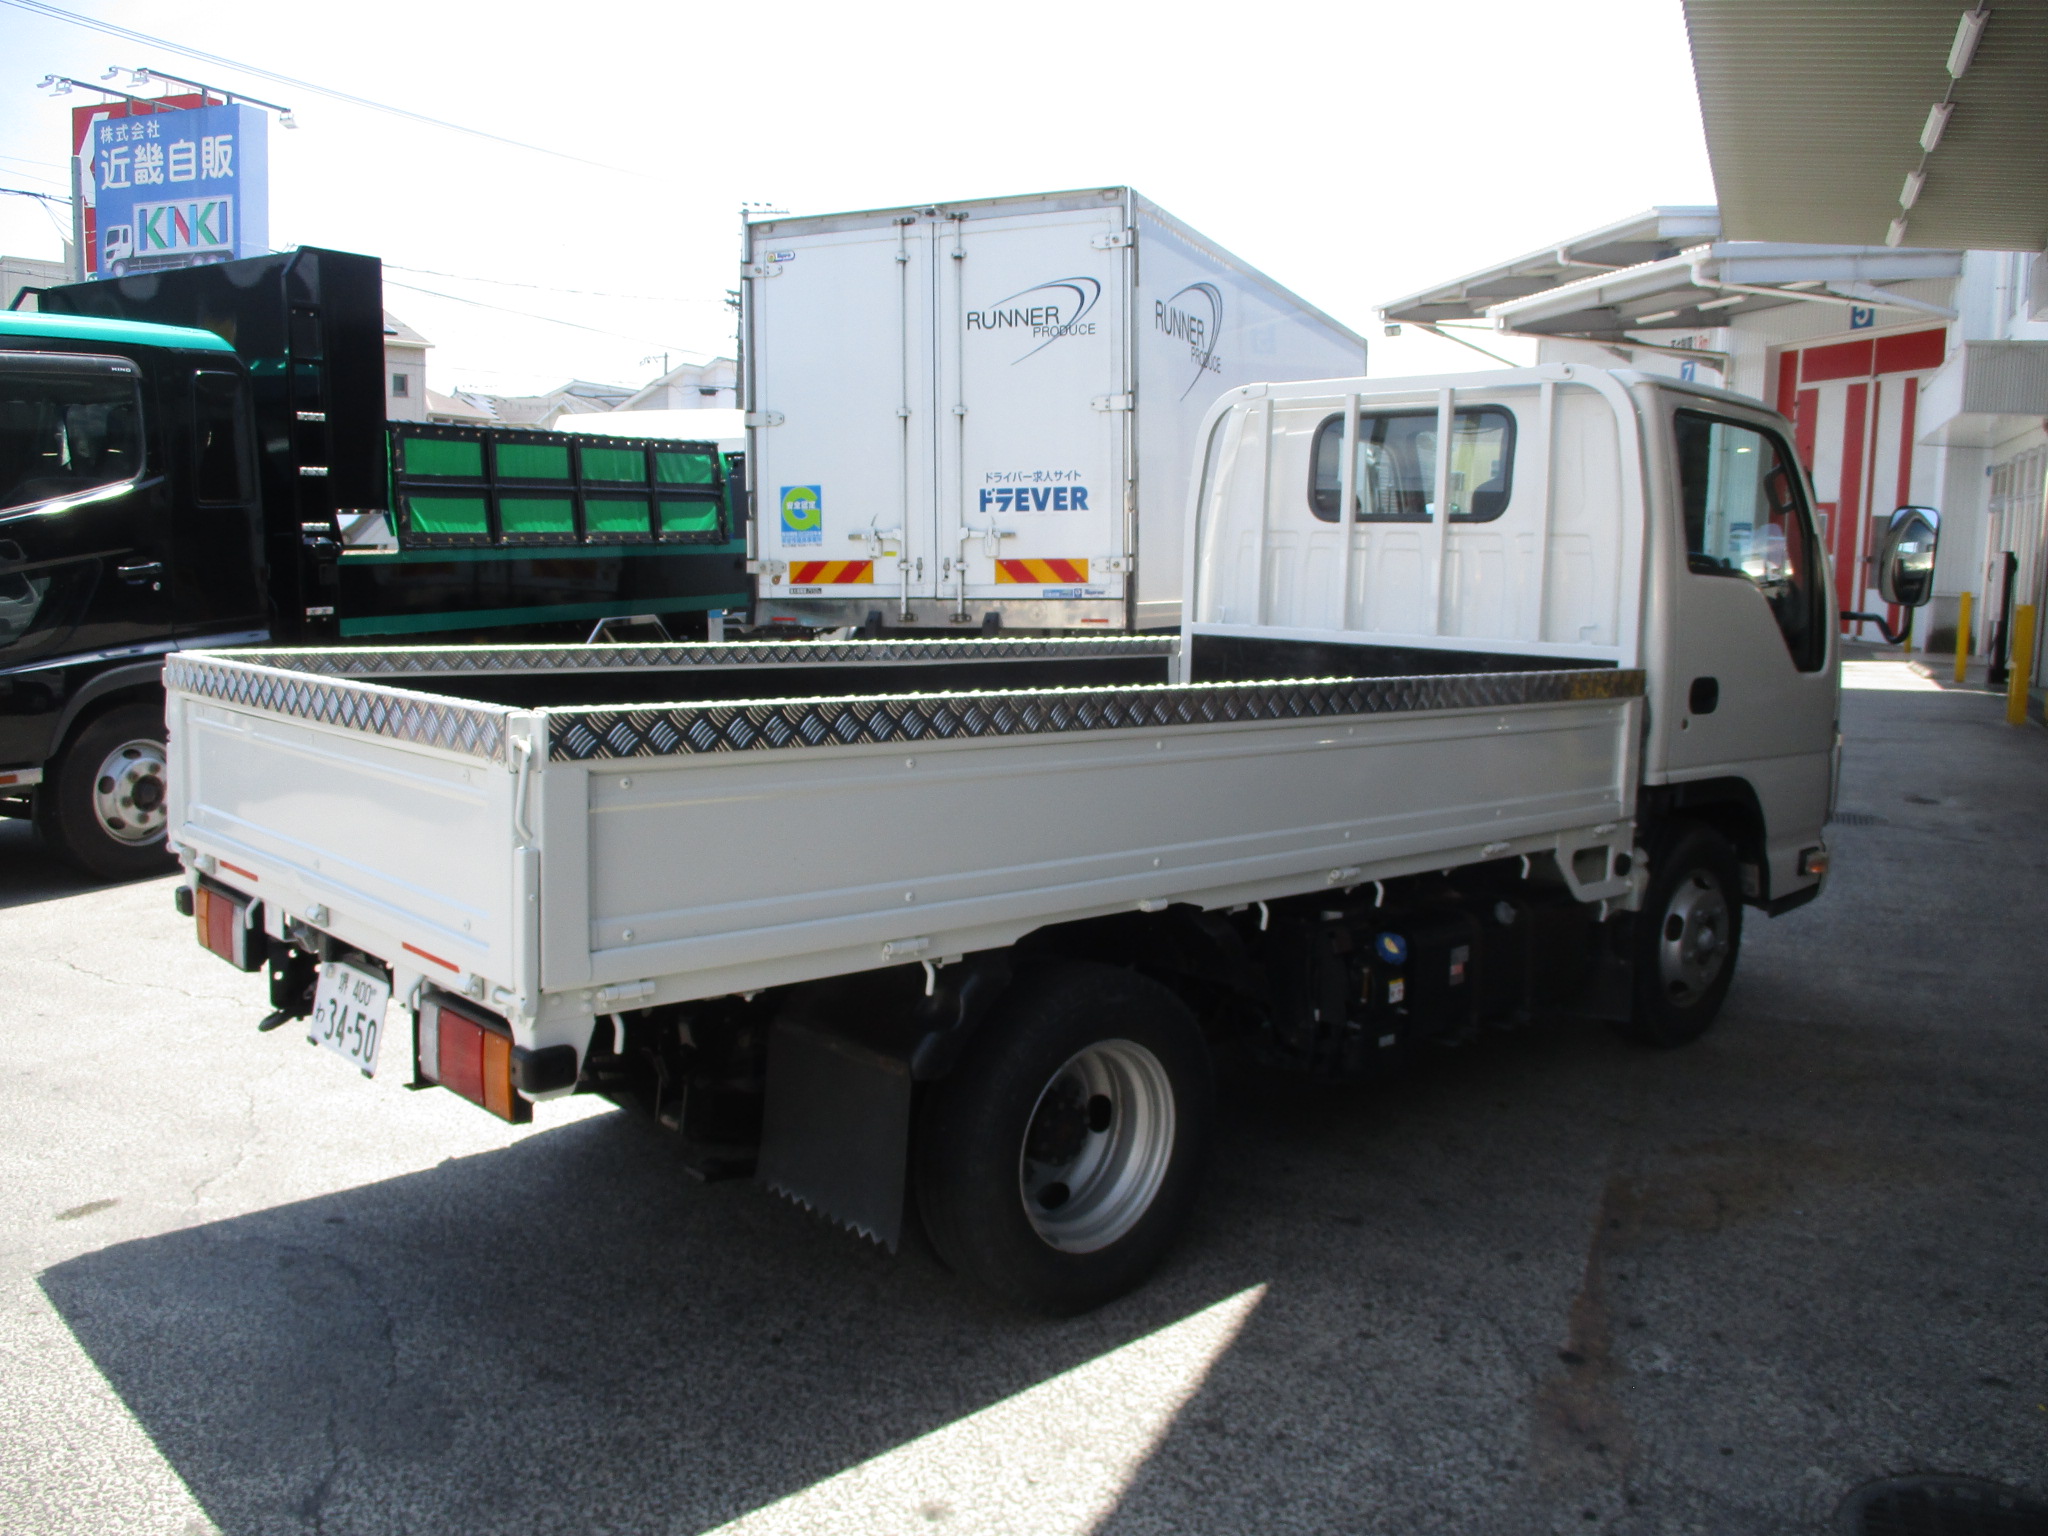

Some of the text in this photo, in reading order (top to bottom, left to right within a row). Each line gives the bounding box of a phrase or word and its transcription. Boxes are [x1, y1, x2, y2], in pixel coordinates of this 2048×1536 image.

[100, 120, 161, 144] 株式会社
[101, 134, 234, 190] 近畿自販
[967, 306, 1059, 330] RUNNER
[1033, 323, 1096, 338] PRODUCE
[1155, 300, 1205, 348] RUNNER
[1190, 346, 1221, 374] PRODUCE
[1683, 364, 1694, 381] 7
[985, 470, 1081, 483] ドライバー求人サイト
[979, 486, 1089, 513] ドラEVER
[353, 980, 371, 1006] 400
[324, 998, 377, 1063] 34-50
